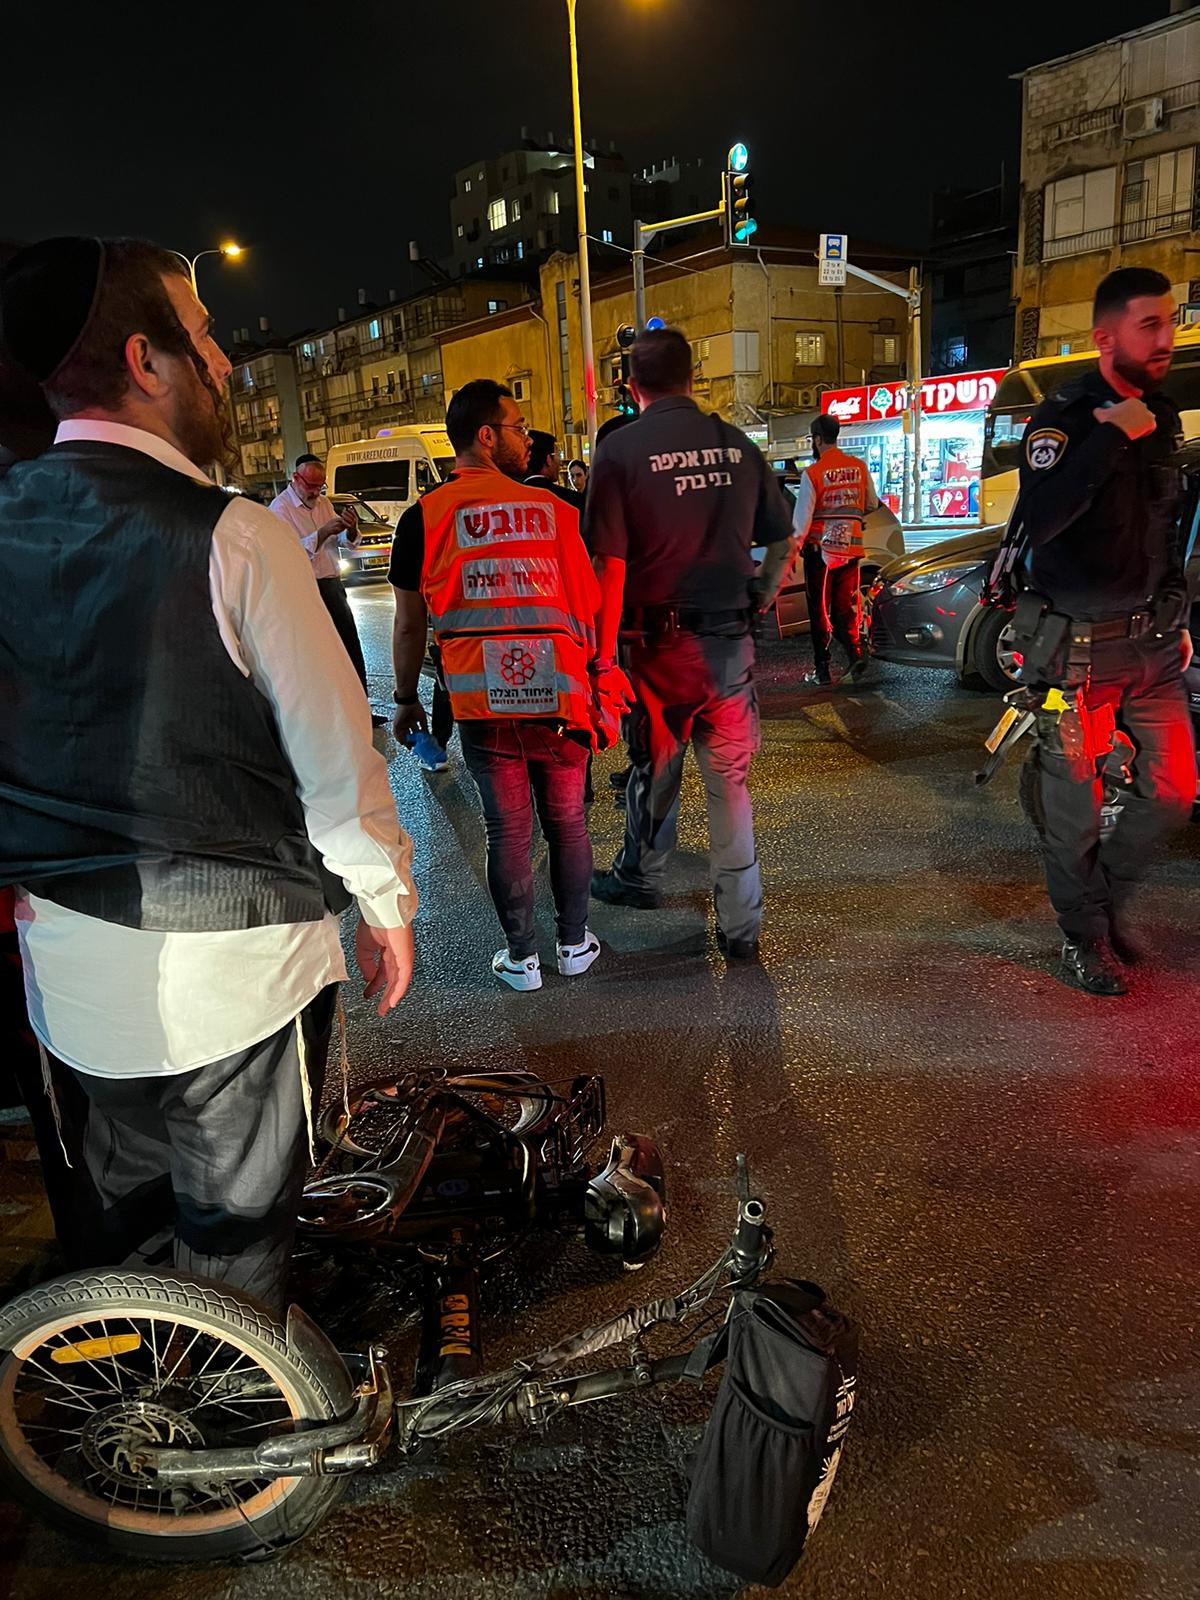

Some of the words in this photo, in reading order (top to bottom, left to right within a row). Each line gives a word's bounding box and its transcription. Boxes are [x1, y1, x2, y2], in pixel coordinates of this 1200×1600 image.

[649, 450, 700, 472] אכיפה
[701, 447, 742, 465] יחדת
[674, 474, 707, 496] ברק
[709, 471, 732, 487] בני
[463, 507, 548, 538] חובש
[467, 571, 506, 588] הצלה
[489, 688, 519, 698] הצלה
[521, 687, 553, 698] איחוד
